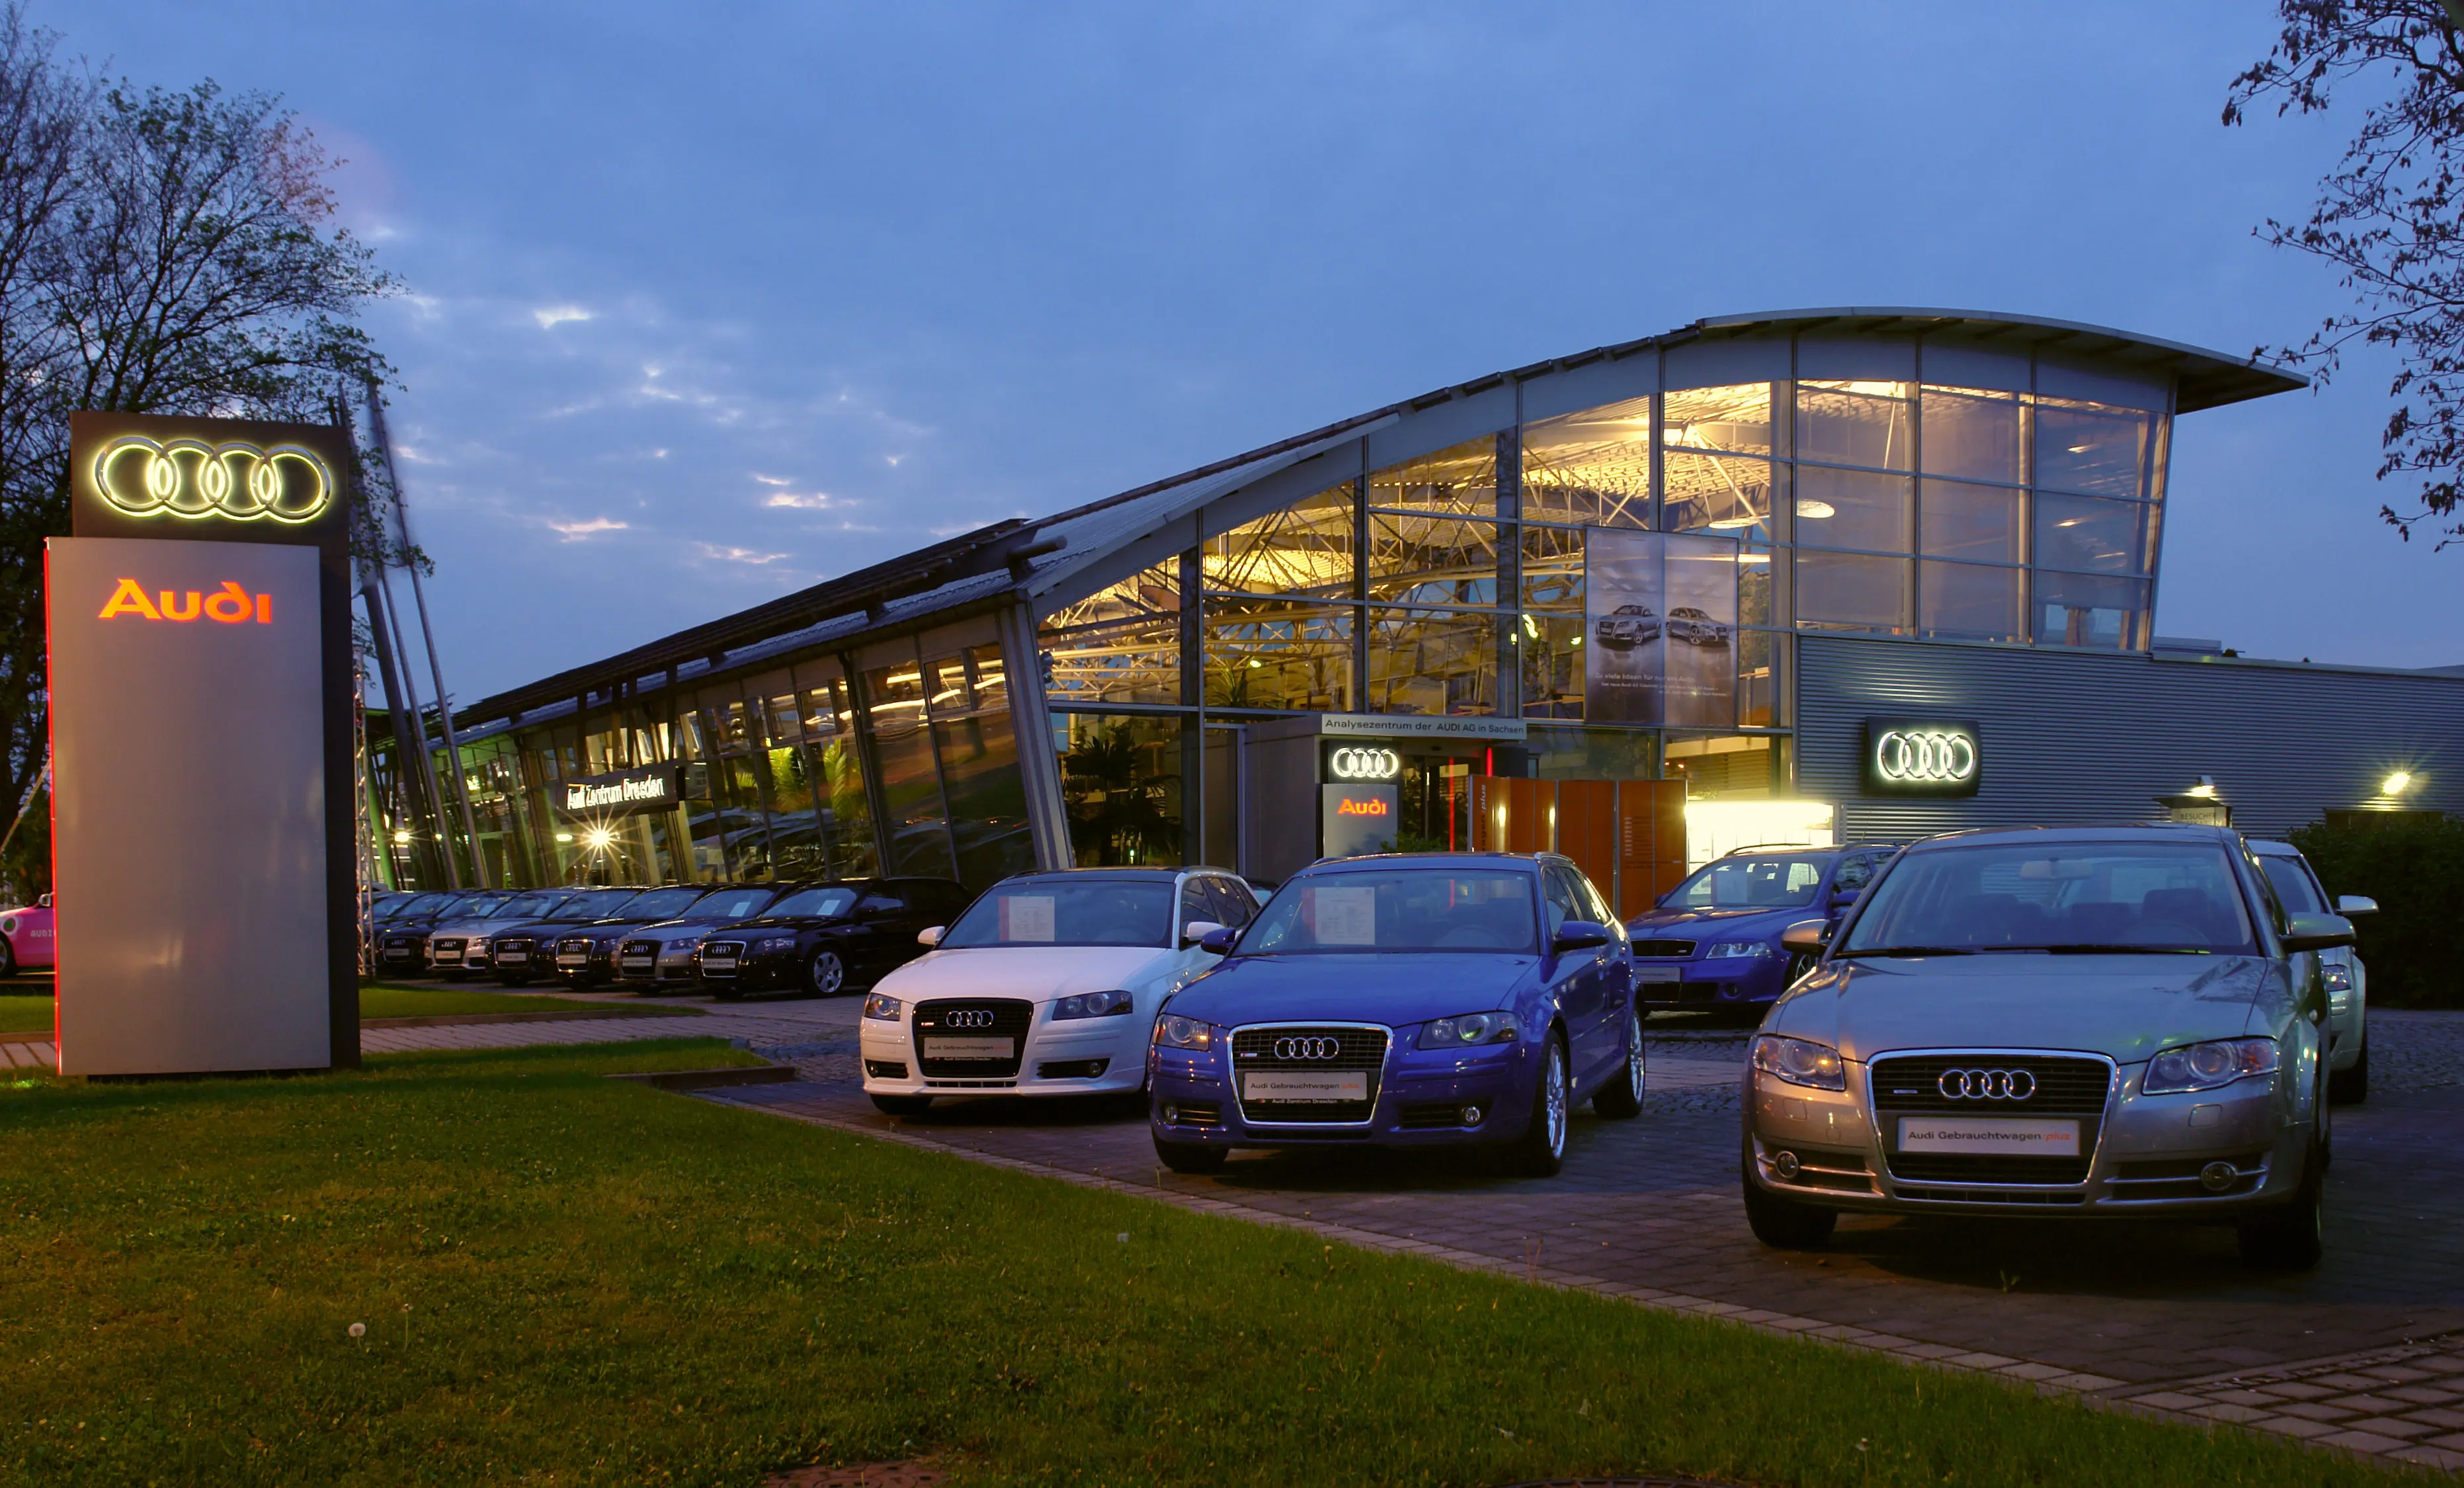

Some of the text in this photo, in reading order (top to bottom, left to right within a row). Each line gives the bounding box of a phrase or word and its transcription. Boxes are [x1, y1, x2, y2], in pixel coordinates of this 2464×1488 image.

[99, 578, 272, 624] Audi
[1325, 720, 1524, 734] Analysezentrum der AUDI AG in Sachsen
[1337, 798, 1387, 815] Audi
[1908, 1131, 1934, 1139] Audi
[1938, 1131, 2041, 1141] Gebrauchtwagen
